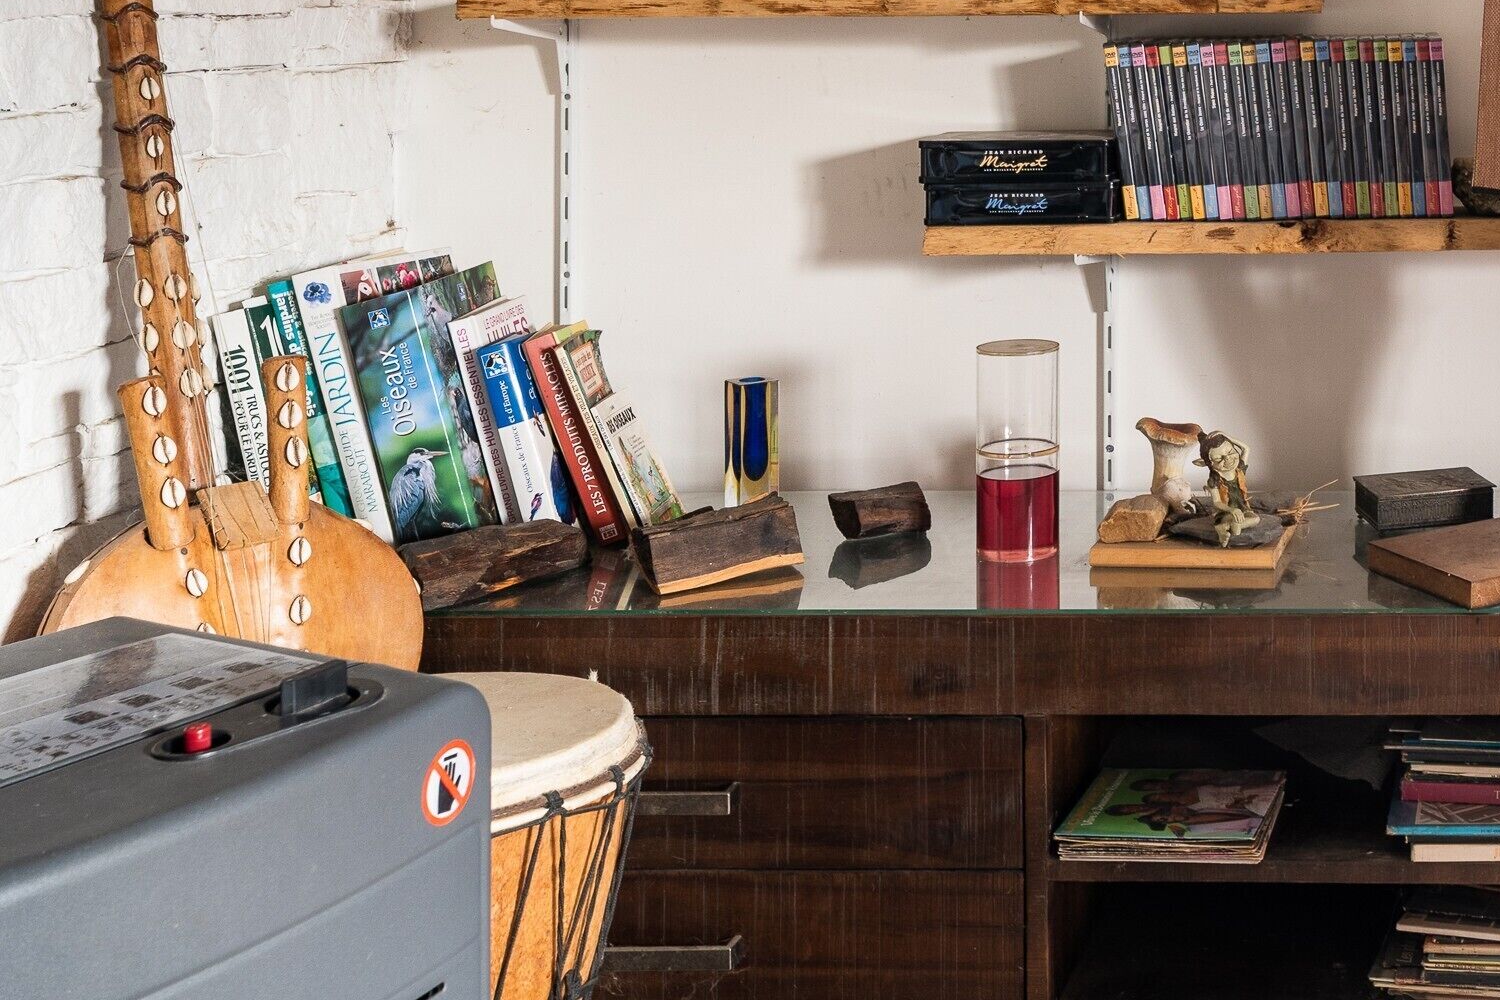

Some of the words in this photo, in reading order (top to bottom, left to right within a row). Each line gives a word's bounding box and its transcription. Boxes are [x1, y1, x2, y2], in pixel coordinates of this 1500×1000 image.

[980, 155, 1048, 174] Maigret
[985, 199, 1048, 215] Maigret
[272, 292, 295, 341] jardins
[286, 290, 300, 320] Secrets
[490, 312, 505, 327] GRAND
[516, 303, 524, 316] DES
[400, 342, 414, 375] France
[457, 328, 486, 406] ESSENTIELLES
[559, 356, 575, 383] VILLAGES
[224, 344, 254, 394] 1001
[246, 393, 261, 429] TRUCS
[254, 430, 264, 441] &
[314, 332, 360, 426] JARDIN
[380, 346, 417, 436] Oiseaux
[408, 376, 418, 389] de
[540, 352, 570, 417] MIRACLES
[381, 396, 391, 415] Les
[499, 380, 512, 413] d'Europe
[574, 392, 587, 411] VILLES
[234, 400, 247, 433] POUR
[478, 407, 496, 447] HUILES
[582, 411, 591, 423] DES
[240, 431, 249, 447] LE
[339, 429, 355, 467] GUIDE
[512, 426, 521, 451] France
[563, 418, 594, 485] PRODUITS
[587, 424, 602, 449] OISEAUX
[491, 449, 501, 466] DES
[355, 448, 379, 512] MARABOUT
[496, 467, 509, 492] LIVRE
[521, 462, 532, 493] Oiseaux
[586, 480, 595, 492] 7
[501, 492, 516, 523] GRAND
[591, 489, 607, 515] LES
